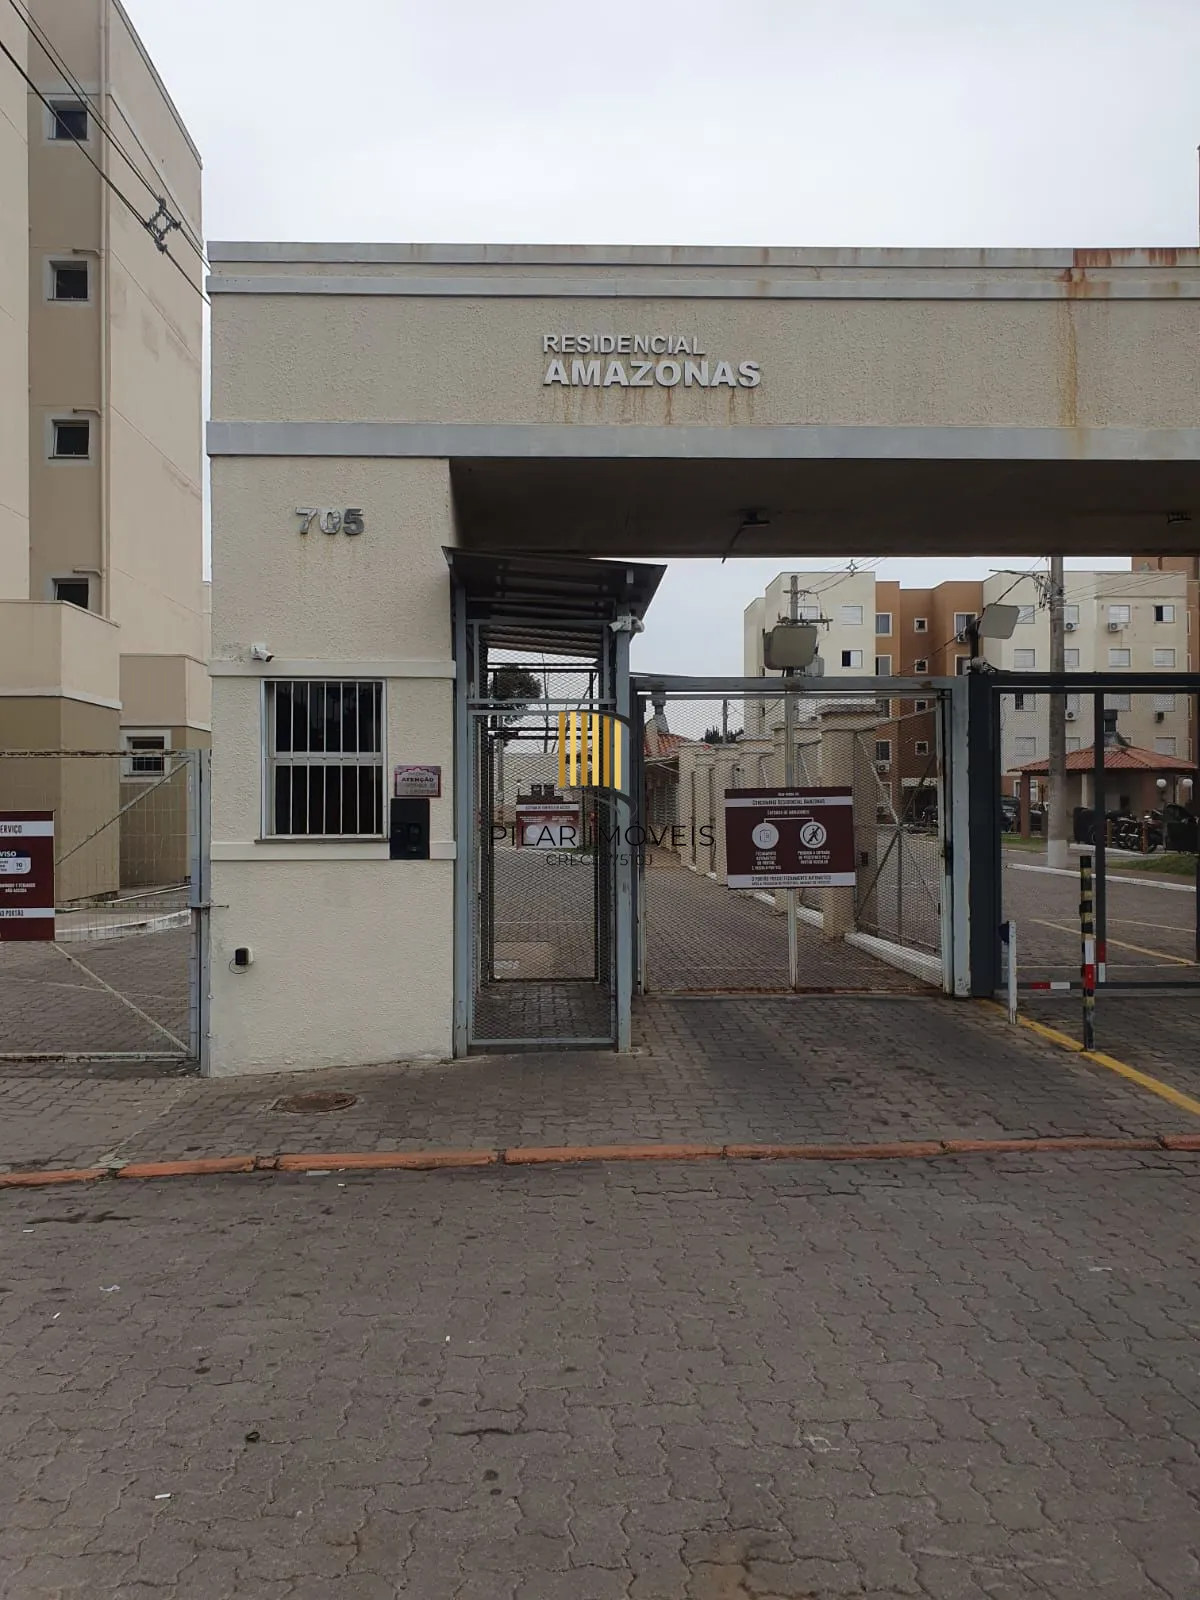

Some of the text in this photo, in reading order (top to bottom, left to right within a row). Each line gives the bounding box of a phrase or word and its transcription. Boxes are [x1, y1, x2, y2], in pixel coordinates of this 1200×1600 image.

[543, 335, 705, 355] RESIDENCIAL
[543, 359, 761, 387] AMAZONAS
[296, 507, 364, 535] 705
